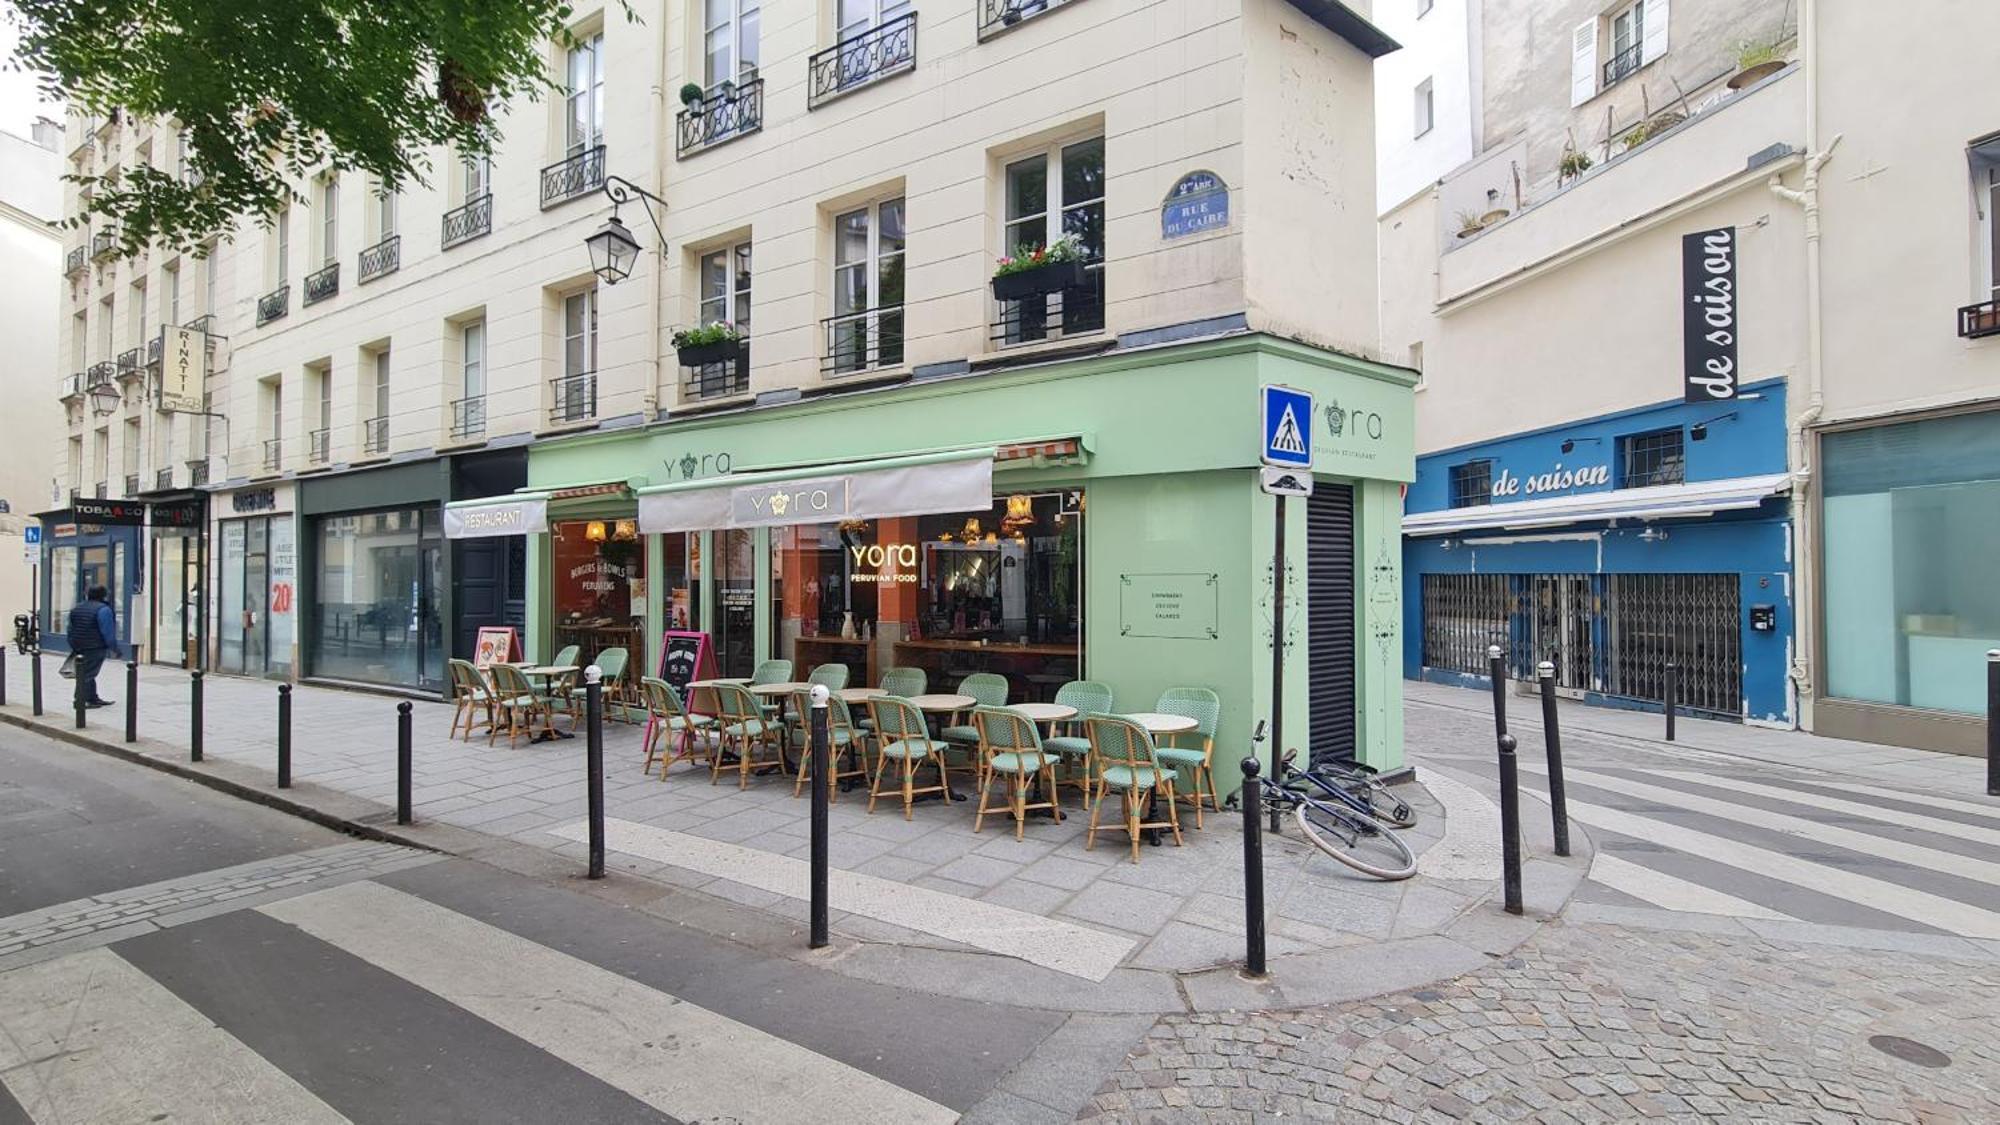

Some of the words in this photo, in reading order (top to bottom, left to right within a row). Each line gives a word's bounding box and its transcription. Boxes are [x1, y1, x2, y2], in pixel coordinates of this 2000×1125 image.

[1167, 222, 1182, 233] DU
[1187, 211, 1226, 228] CAIRE
[1182, 202, 1209, 217] RUE
[1693, 230, 1733, 346] saison
[179, 331, 189, 391] RINATTI
[1689, 355, 1734, 398] de
[1492, 468, 1519, 496] de
[1524, 463, 1609, 494] saison
[464, 510, 521, 529] RESTAURANT
[851, 574, 890, 582] PERUVIAN
[893, 574, 917, 582] FOOD
